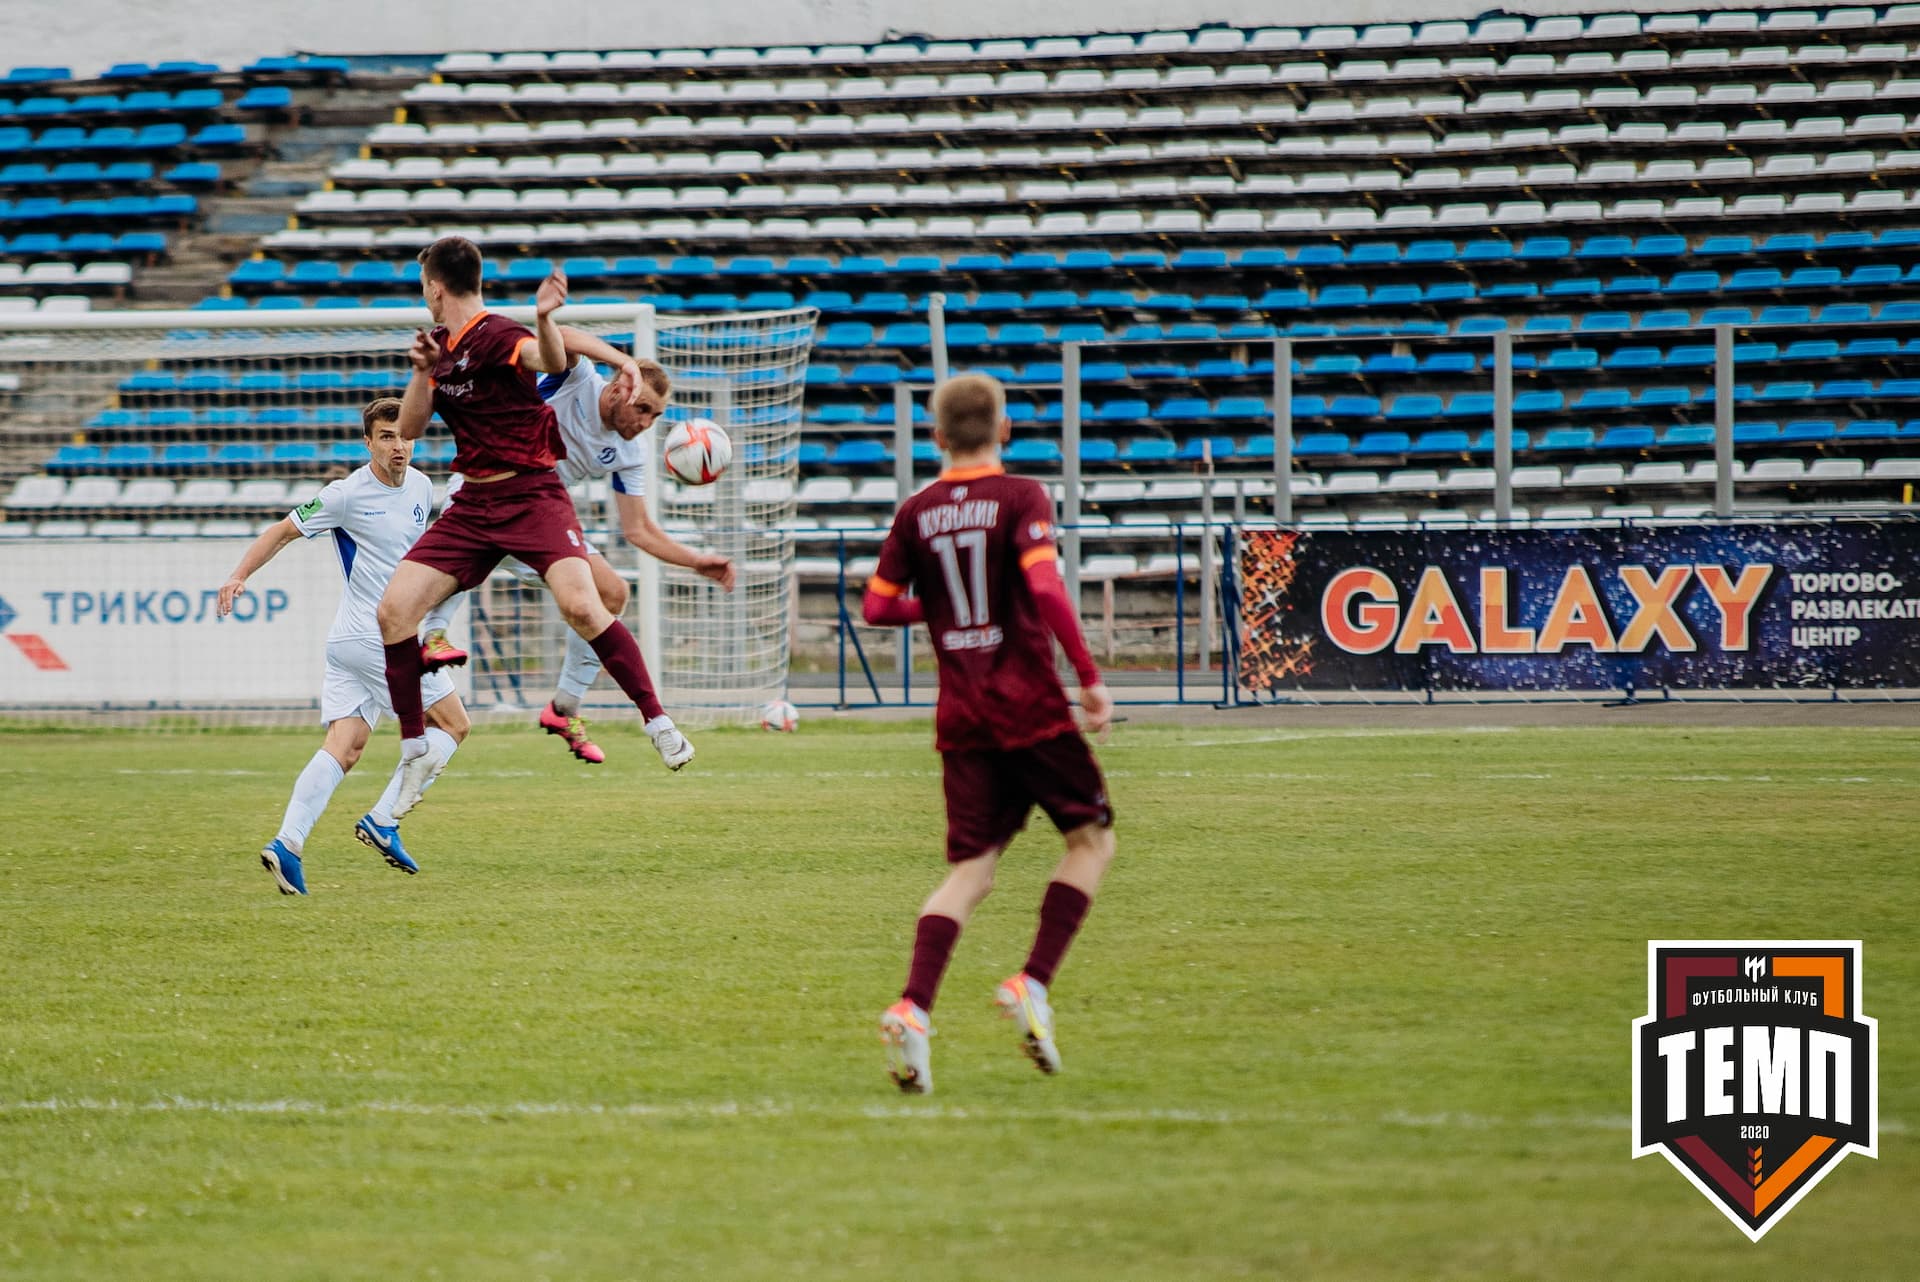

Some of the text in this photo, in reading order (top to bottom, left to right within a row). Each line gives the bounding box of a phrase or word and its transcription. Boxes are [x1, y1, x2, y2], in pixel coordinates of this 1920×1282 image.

[918, 500, 999, 539] КУЗЬКИН
[930, 529, 989, 628] 17
[1790, 572, 1902, 593] ТОРГОВО-
[42, 590, 289, 624] ТРИКОЛОР
[1321, 564, 1773, 654] GALAXY
[1791, 626, 1861, 649] ЦЕНТР
